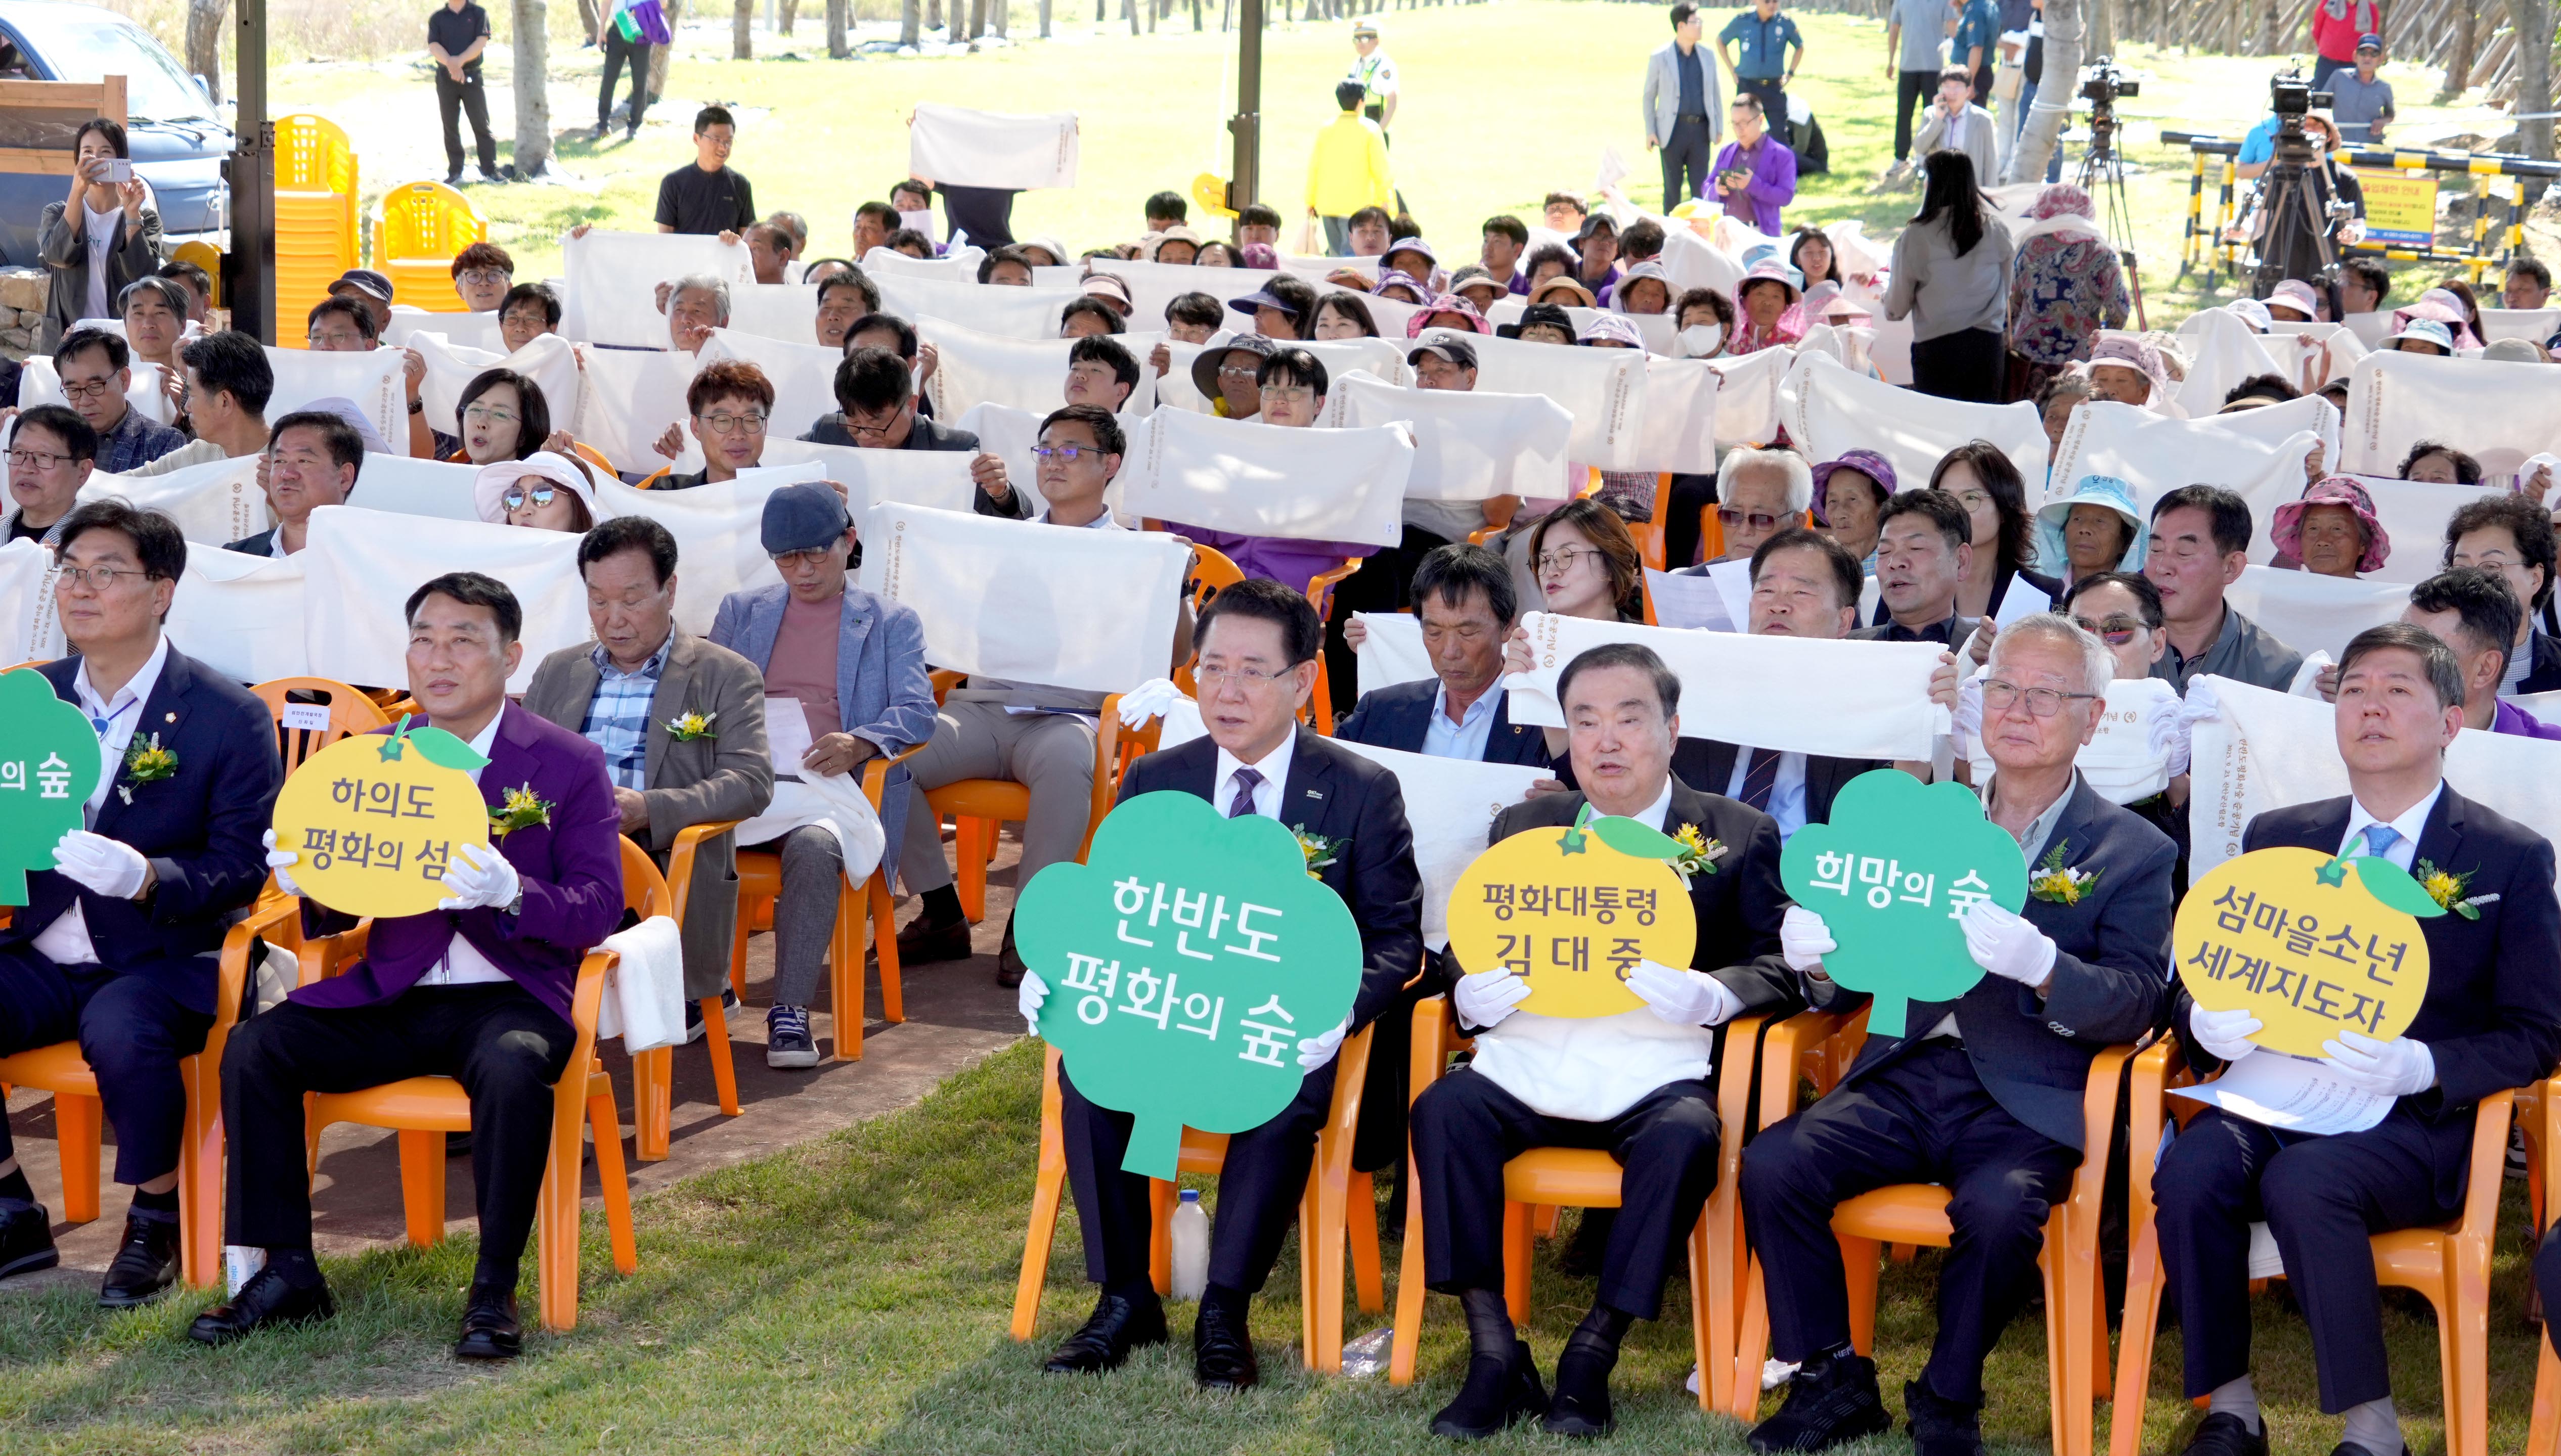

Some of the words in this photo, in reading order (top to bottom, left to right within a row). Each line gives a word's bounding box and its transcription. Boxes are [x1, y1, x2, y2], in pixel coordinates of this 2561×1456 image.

[893, 535, 902, 581] 한반도평화의숲
[38, 574, 52, 602] 준공기념
[1547, 617, 1559, 650] 준공기념
[36, 751, 72, 799] 숲
[332, 777, 436, 820] 하의도
[2217, 781, 2230, 827] 신안군산림조합
[2229, 801, 2242, 838] 준공기념
[302, 827, 404, 871] 평화의
[415, 839, 450, 881] 섬
[1483, 883, 1658, 927] 평화대통령
[1809, 850, 1935, 909] 희망의
[1948, 869, 1991, 920] 숲
[1113, 876, 1284, 963] 한반도
[2213, 884, 2408, 987] 섬마을소년
[1061, 952, 1225, 1041] 평화의
[1238, 994, 1297, 1068] 숲
[2187, 939, 2386, 1035] 세계지도자
